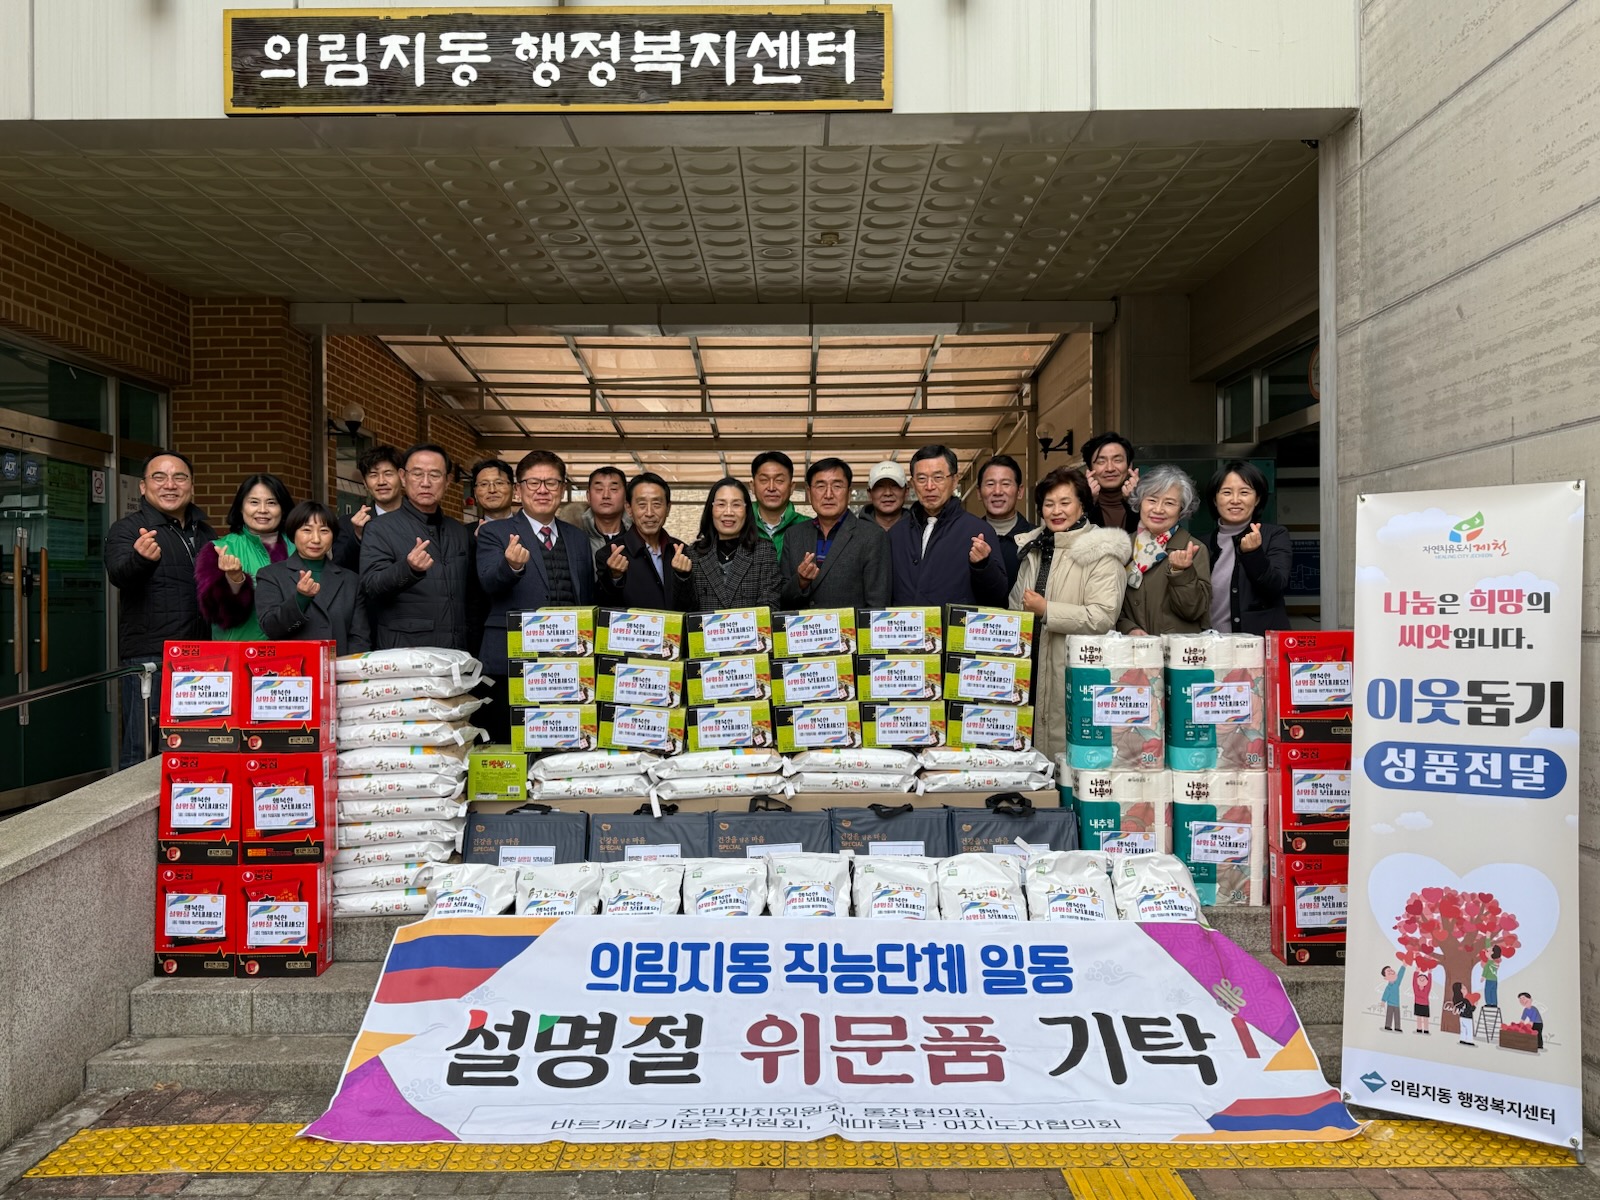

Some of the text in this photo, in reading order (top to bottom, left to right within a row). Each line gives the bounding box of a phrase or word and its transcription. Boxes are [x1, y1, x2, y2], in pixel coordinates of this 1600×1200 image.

[260, 29, 857, 87] 의림지동 행정복지센터
[5, 461, 16, 471] ADT
[26, 467, 37, 476] ADT
[1423, 539, 1509, 557] 자연치유도시 제천
[1383, 589, 1551, 615] 나눔은 희망의
[1298, 639, 1316, 647] 농심
[1398, 624, 1533, 649] 씨앗입니다.
[1366, 678, 1564, 728] 이웃돕기
[1380, 747, 1549, 791] 성품전달
[1090, 818, 1114, 828] 내추럴
[586, 941, 1074, 995] 의림지동 직능단체 일동
[445, 1009, 704, 1088] 설명절
[740, 1012, 1007, 1085] 위문품
[1391, 1079, 1556, 1124] 의림지동 행정복지센터
